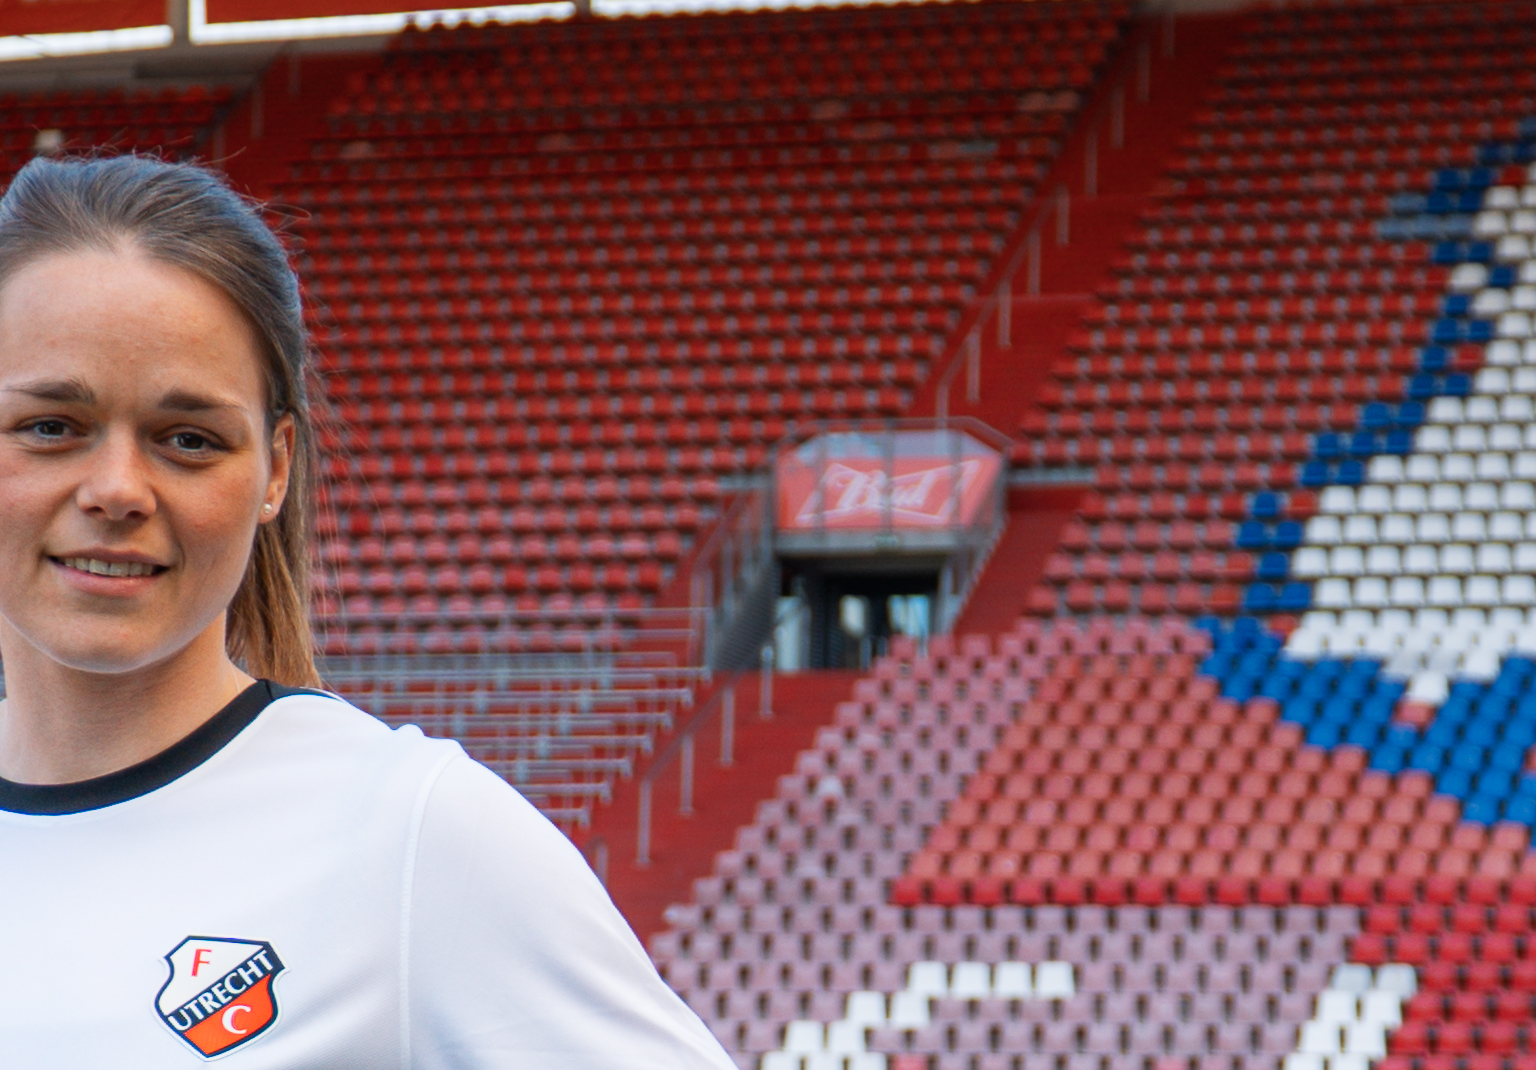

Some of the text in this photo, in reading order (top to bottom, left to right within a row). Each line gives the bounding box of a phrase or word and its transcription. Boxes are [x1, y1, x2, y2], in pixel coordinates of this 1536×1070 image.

[826, 469, 938, 510] Bud
[191, 948, 212, 977] F
[167, 950, 273, 1031] UTRECHT
[221, 1005, 252, 1035] C
